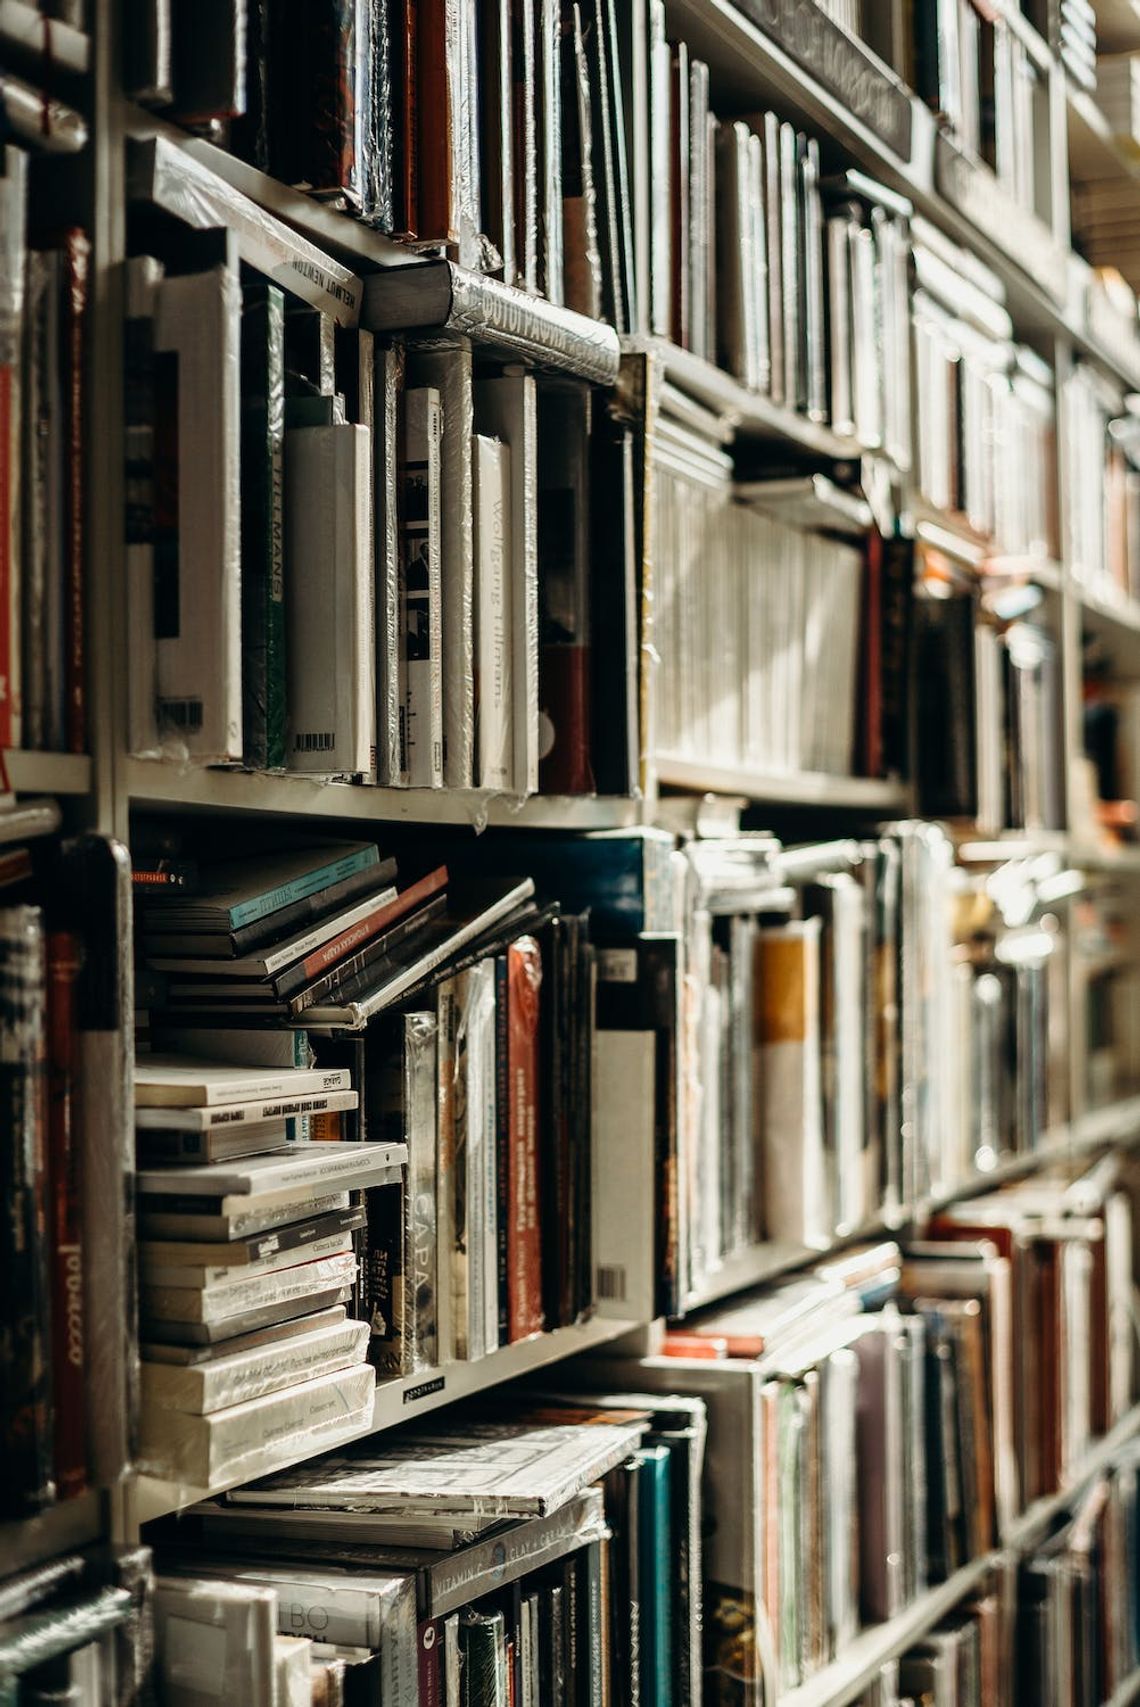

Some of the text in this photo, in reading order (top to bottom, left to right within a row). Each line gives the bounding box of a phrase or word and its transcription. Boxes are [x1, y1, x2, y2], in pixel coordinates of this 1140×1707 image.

[291, 260, 357, 309] HELMUT NEWTON
[490, 499, 505, 606] Wolfgang
[414, 1194, 430, 1291] CAPA
[435, 1569, 476, 1597] VITAMIN
